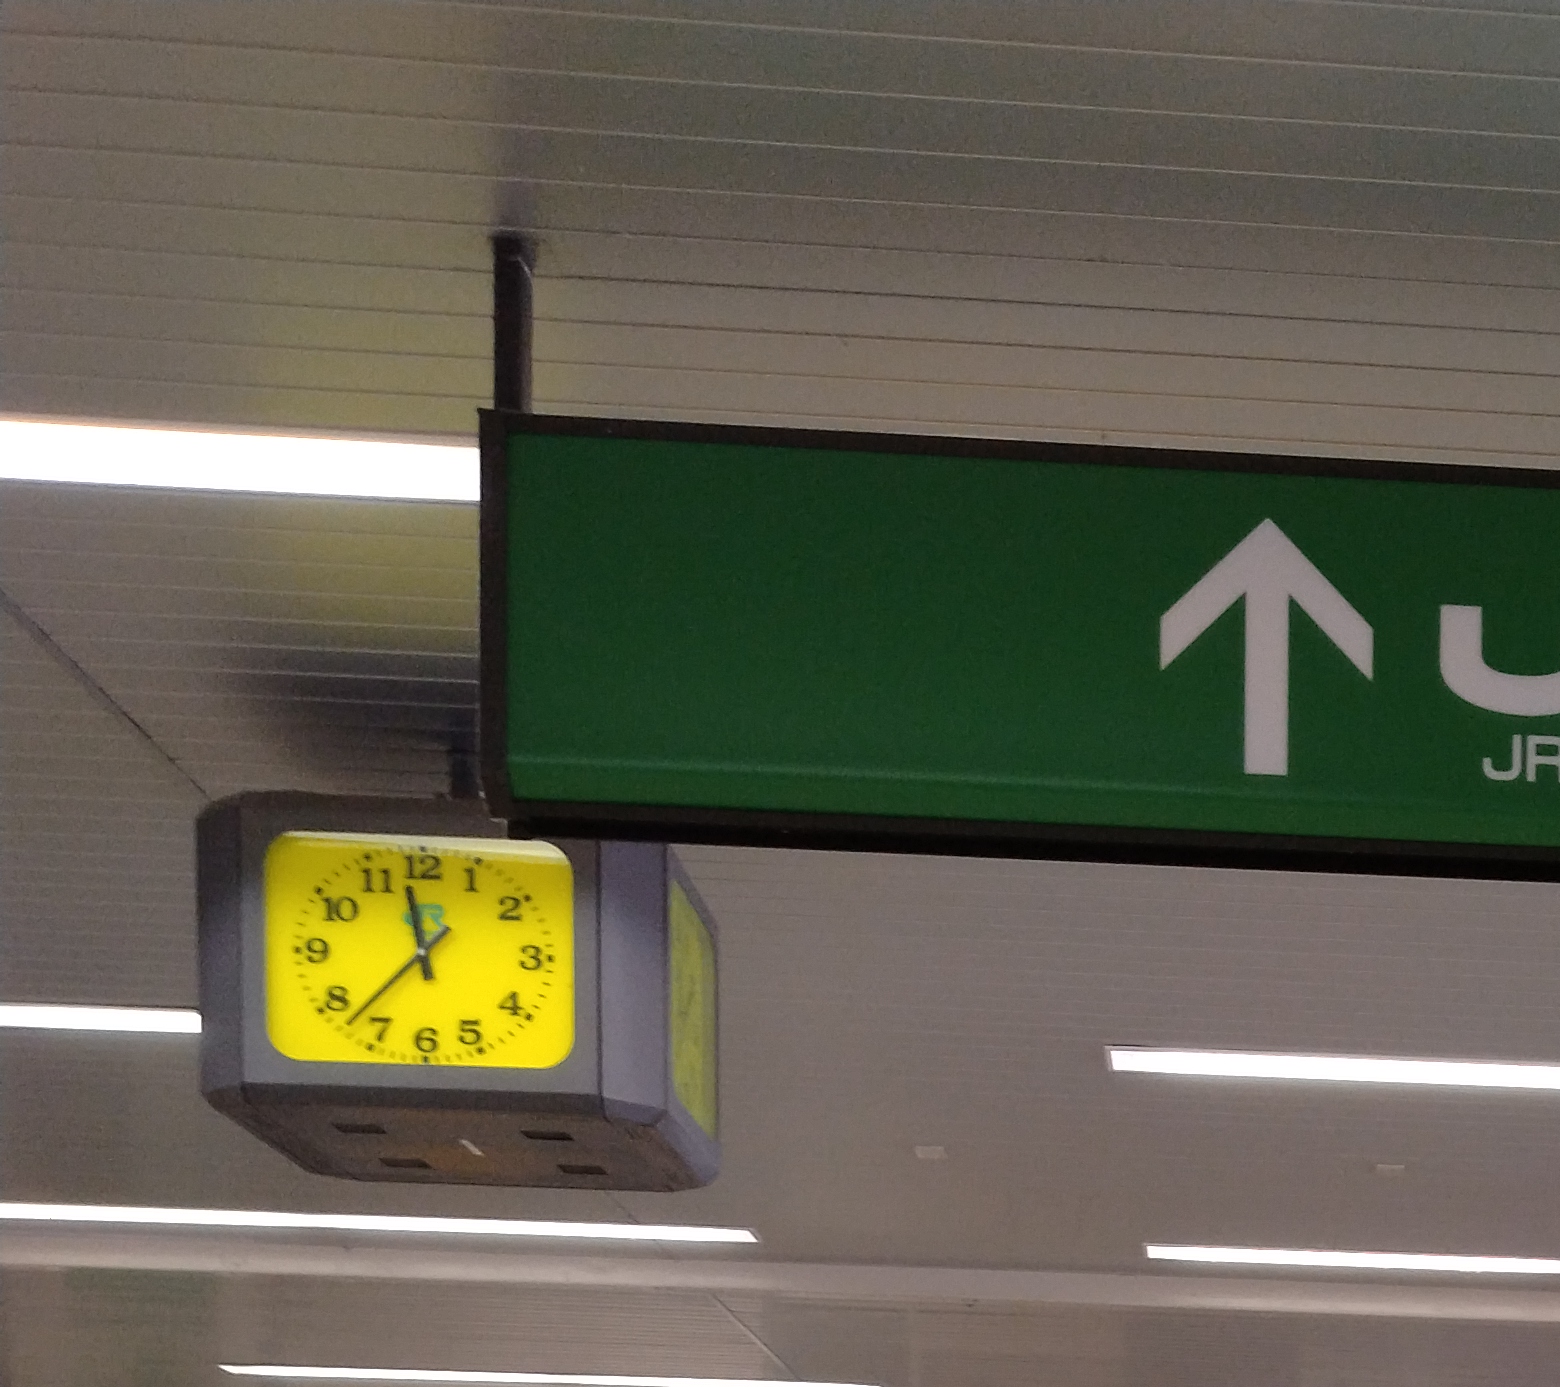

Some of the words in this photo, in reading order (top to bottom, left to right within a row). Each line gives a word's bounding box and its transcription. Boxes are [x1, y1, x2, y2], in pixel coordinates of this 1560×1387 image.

[404, 854, 442, 880] 12
[464, 867, 478, 892] 1
[362, 868, 394, 894] 11
[323, 897, 360, 921] 10
[498, 897, 523, 922] 2
[305, 939, 330, 963] 9
[520, 946, 543, 970] 3
[325, 986, 350, 1012] 8
[499, 992, 525, 1016] 4
[370, 1017, 393, 1042] 7
[415, 1028, 438, 1053] 6
[459, 1020, 482, 1045] 5
